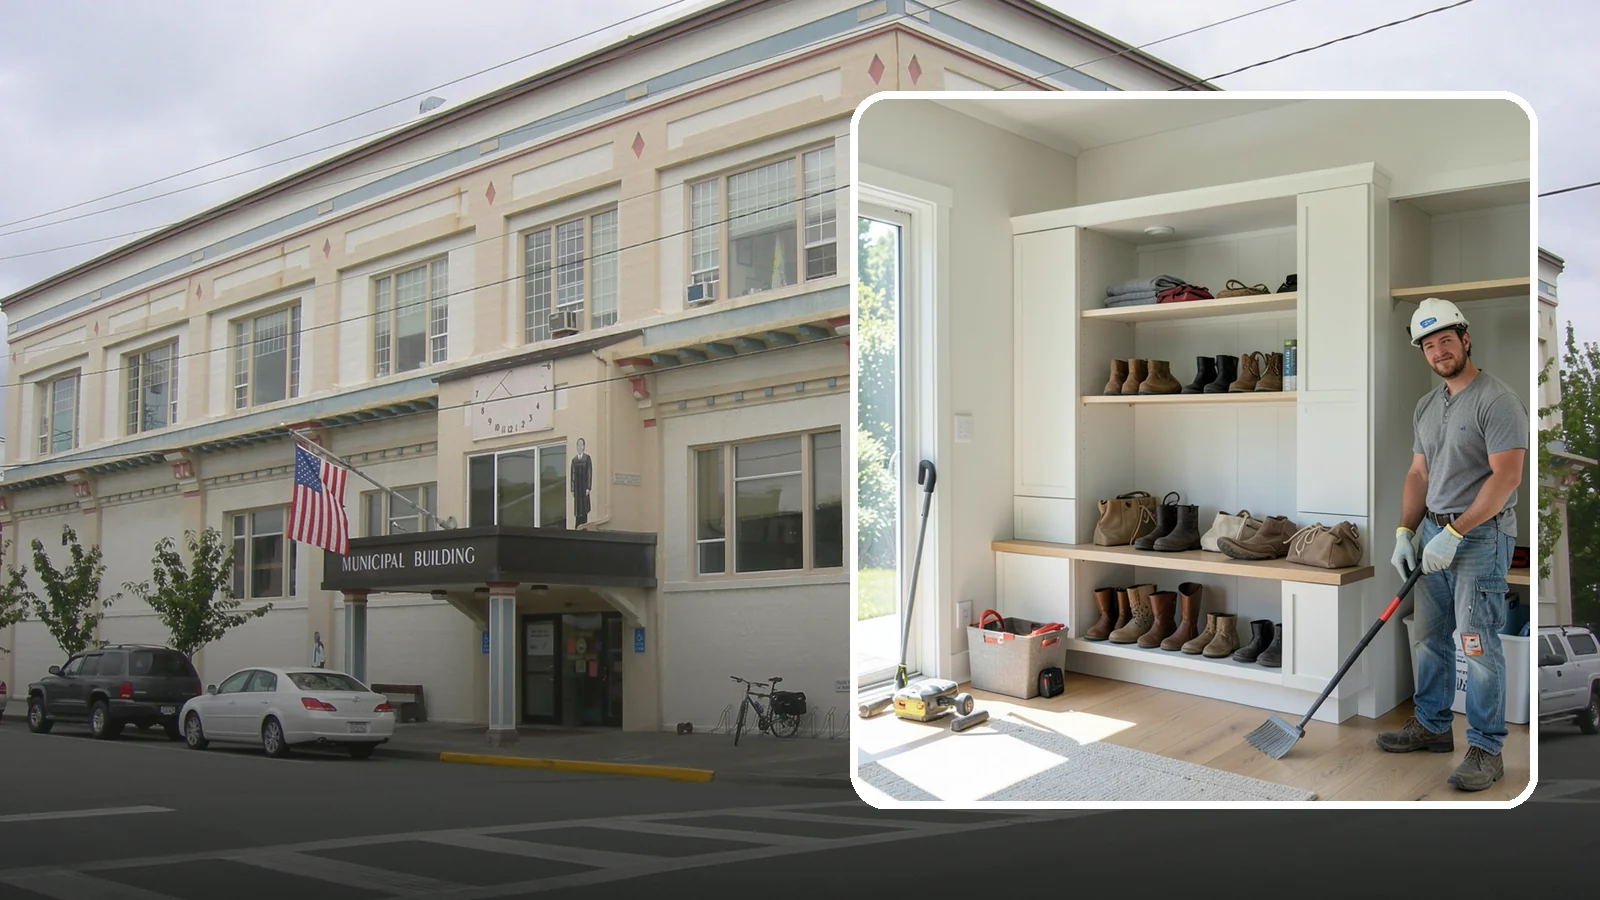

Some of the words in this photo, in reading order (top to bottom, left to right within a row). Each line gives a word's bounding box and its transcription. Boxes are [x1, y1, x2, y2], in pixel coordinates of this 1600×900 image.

[475, 390, 479, 398] 7
[536, 402, 540, 410] 4
[481, 407, 485, 415] 8
[488, 417, 492, 425] 9
[529, 414, 533, 422] 3
[494, 423, 500, 432] 10
[521, 420, 525, 428] 2
[342, 552, 405, 572] MUNICIPAL
[414, 546, 475, 567] BUILDING
